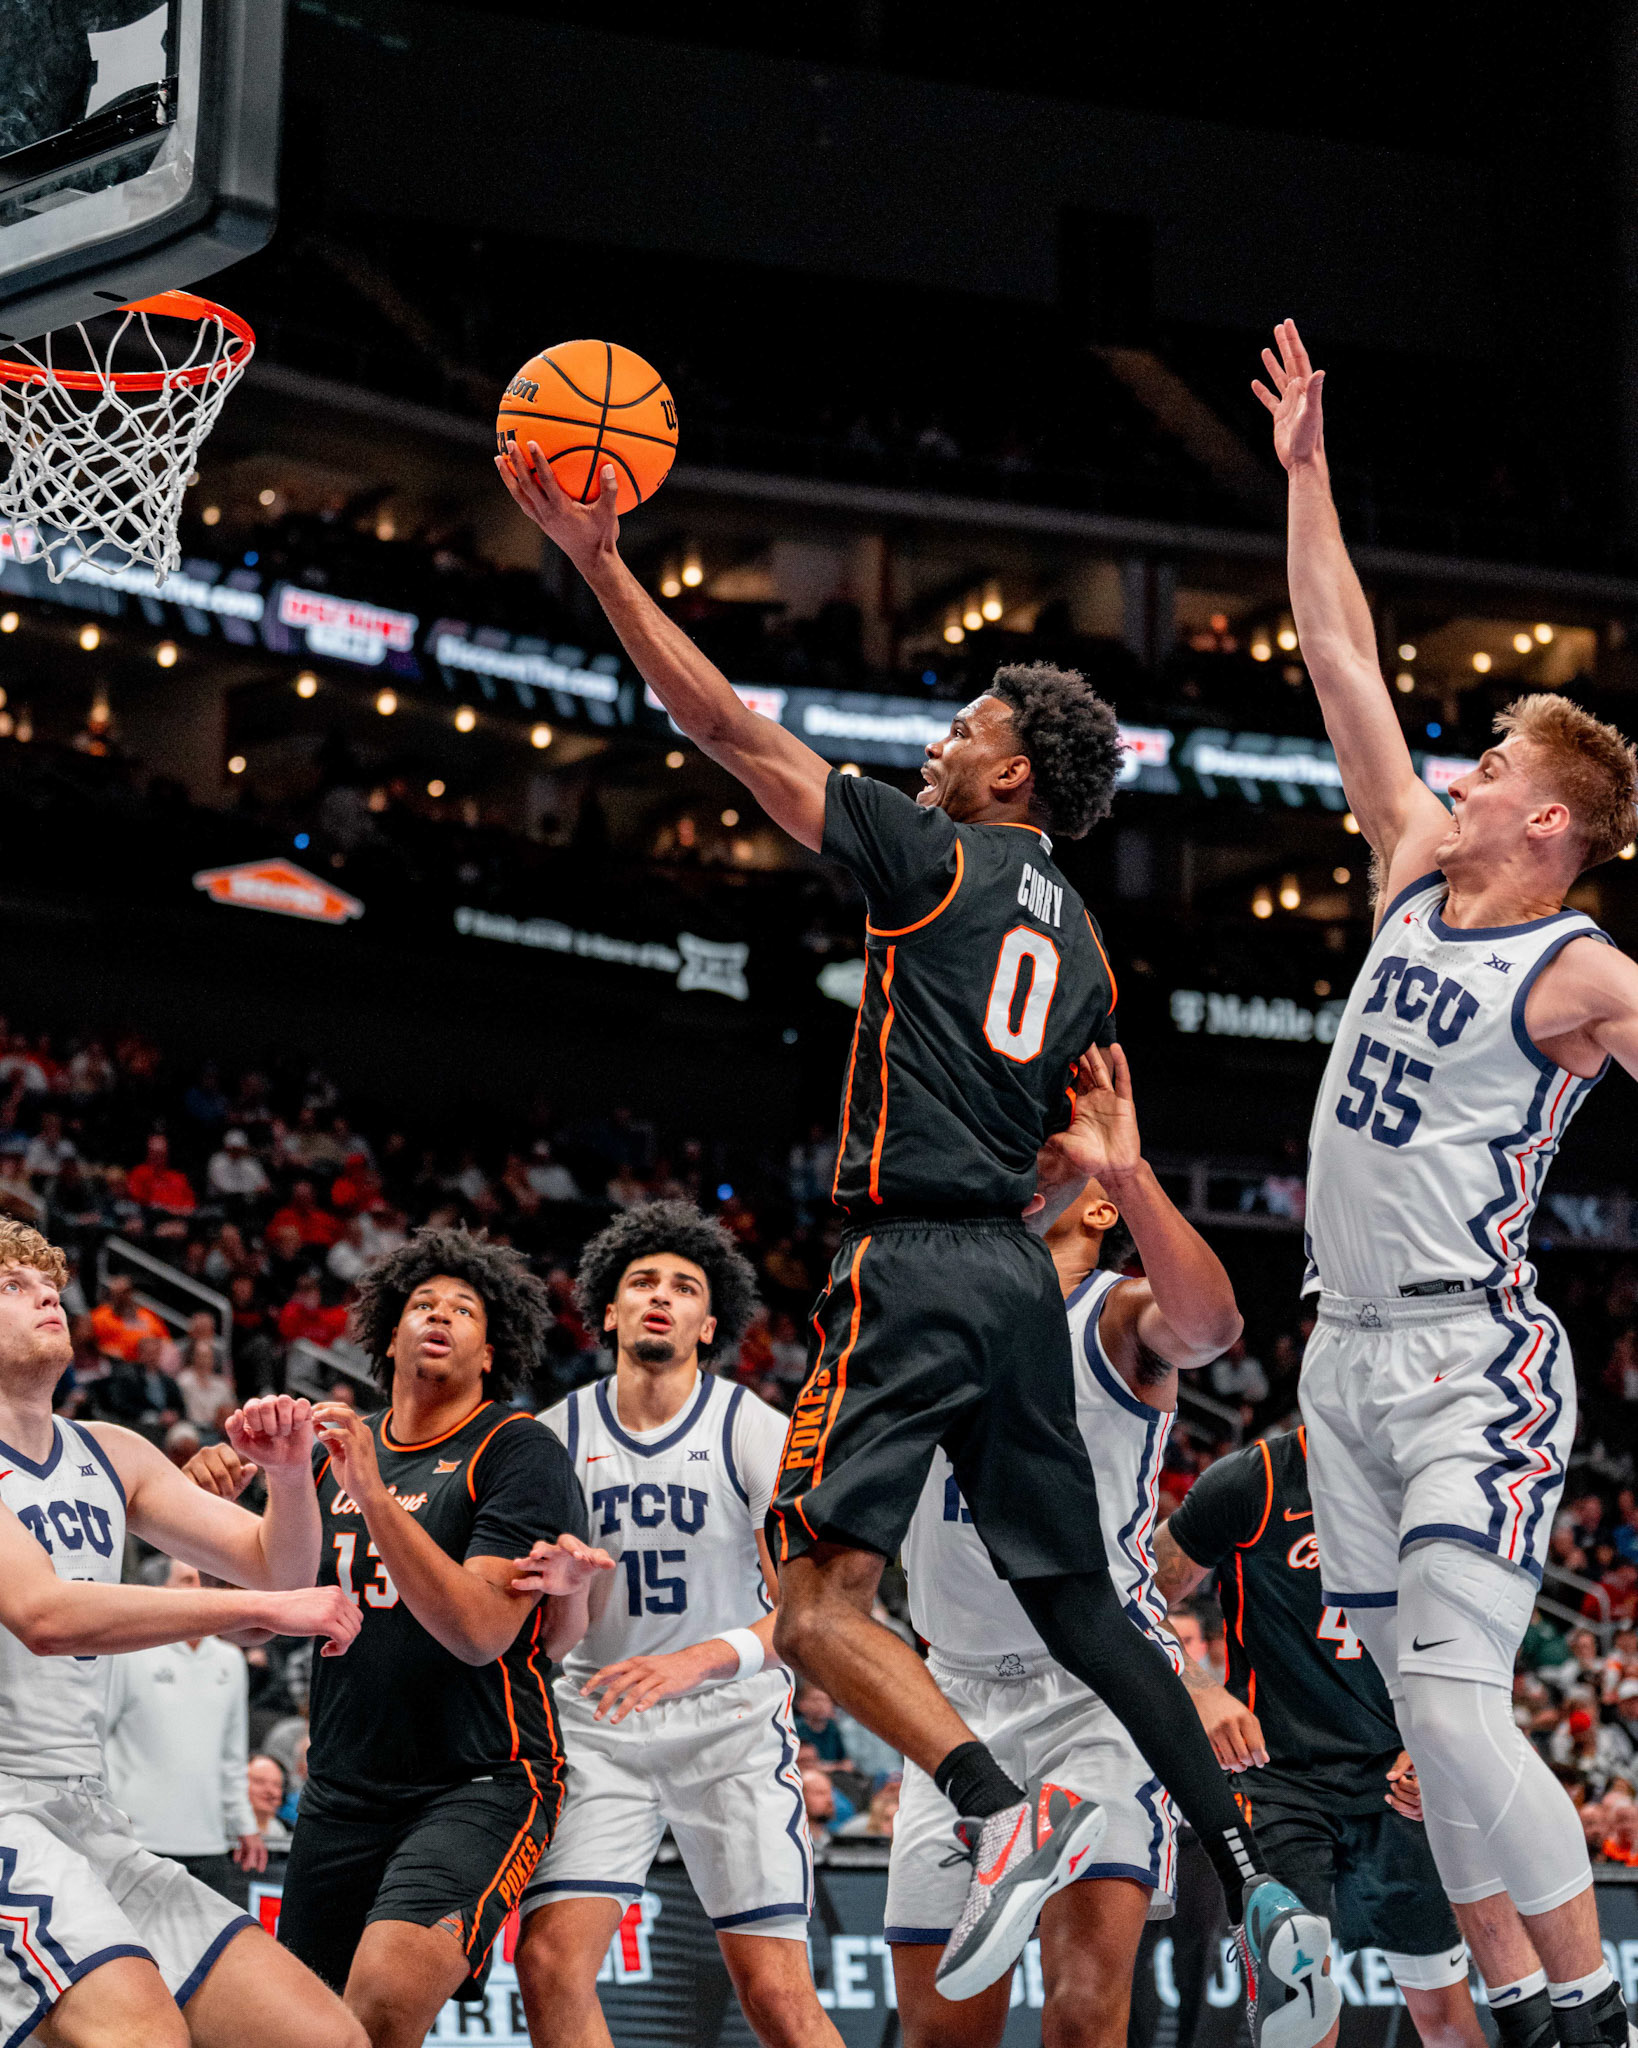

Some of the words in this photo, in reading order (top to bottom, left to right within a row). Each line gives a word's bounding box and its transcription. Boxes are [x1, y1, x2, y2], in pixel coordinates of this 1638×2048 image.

[1017, 862, 1063, 928] CURRY
[982, 924, 1061, 1064] 0
[1361, 955, 1480, 1048] TCU
[1335, 1033, 1434, 1148] 55
[17, 1499, 114, 1559] TCU
[593, 1483, 709, 1538] TCU
[333, 1533, 400, 1609] 13
[619, 1550, 688, 1618] 15
[1316, 1605, 1363, 1660] 4
[498, 1836, 538, 1909] POKES
